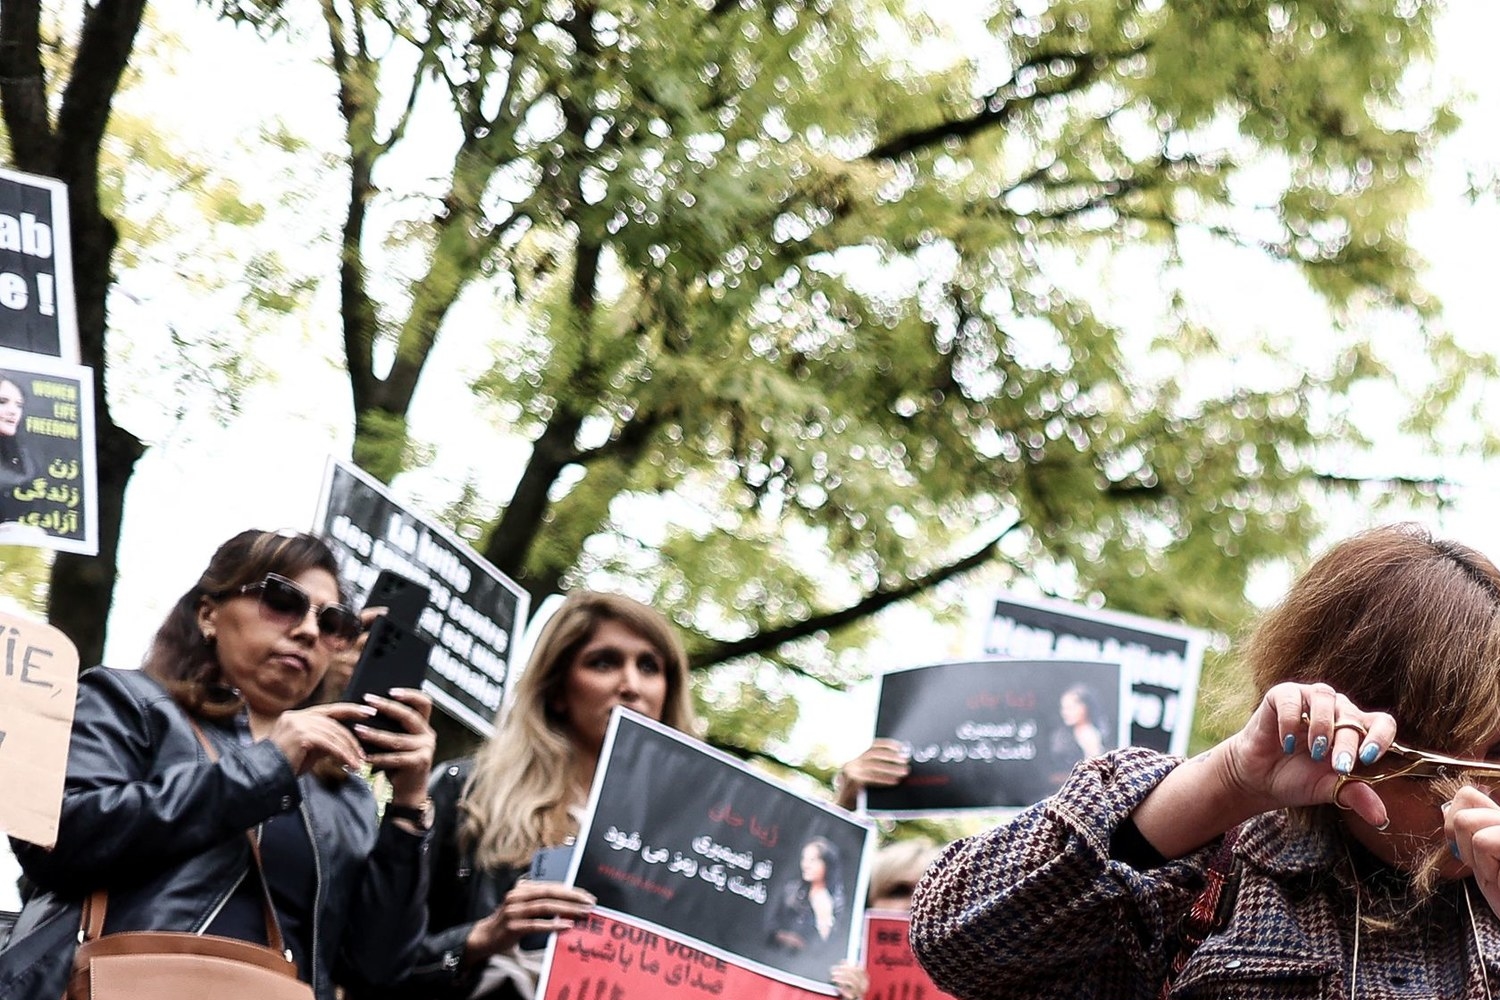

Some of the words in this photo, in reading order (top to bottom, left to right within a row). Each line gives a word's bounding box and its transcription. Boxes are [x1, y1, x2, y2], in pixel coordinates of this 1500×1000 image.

[48, 458, 79, 480] زن
[13, 477, 80, 508] زندگی
[387, 512, 418, 555] La
[567, 937, 633, 973] باشید
[640, 949, 660, 974] ما
[664, 962, 725, 995] صدای
